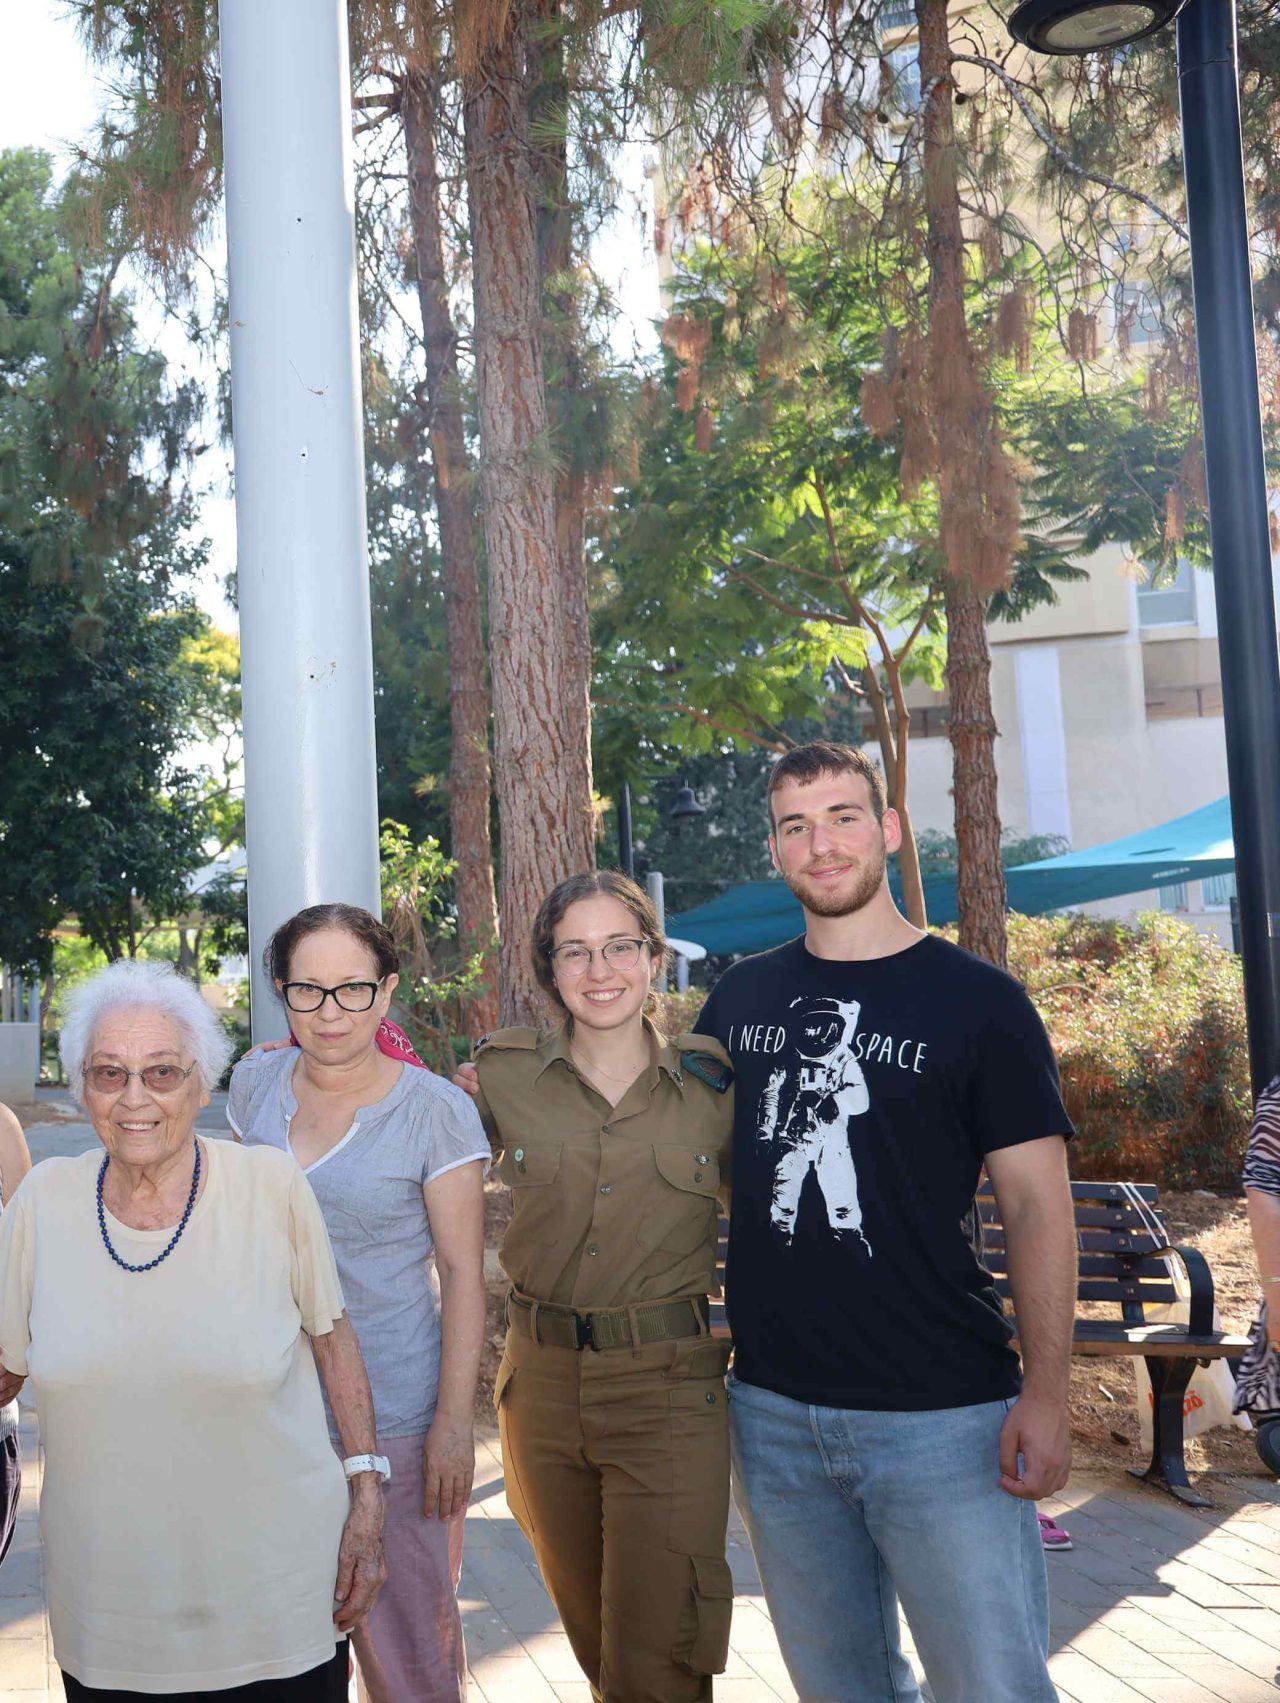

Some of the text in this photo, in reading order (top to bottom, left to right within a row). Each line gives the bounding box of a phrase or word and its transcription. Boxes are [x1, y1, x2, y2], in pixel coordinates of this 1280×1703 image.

[727, 1024, 929, 1075] I NEED SPACE
